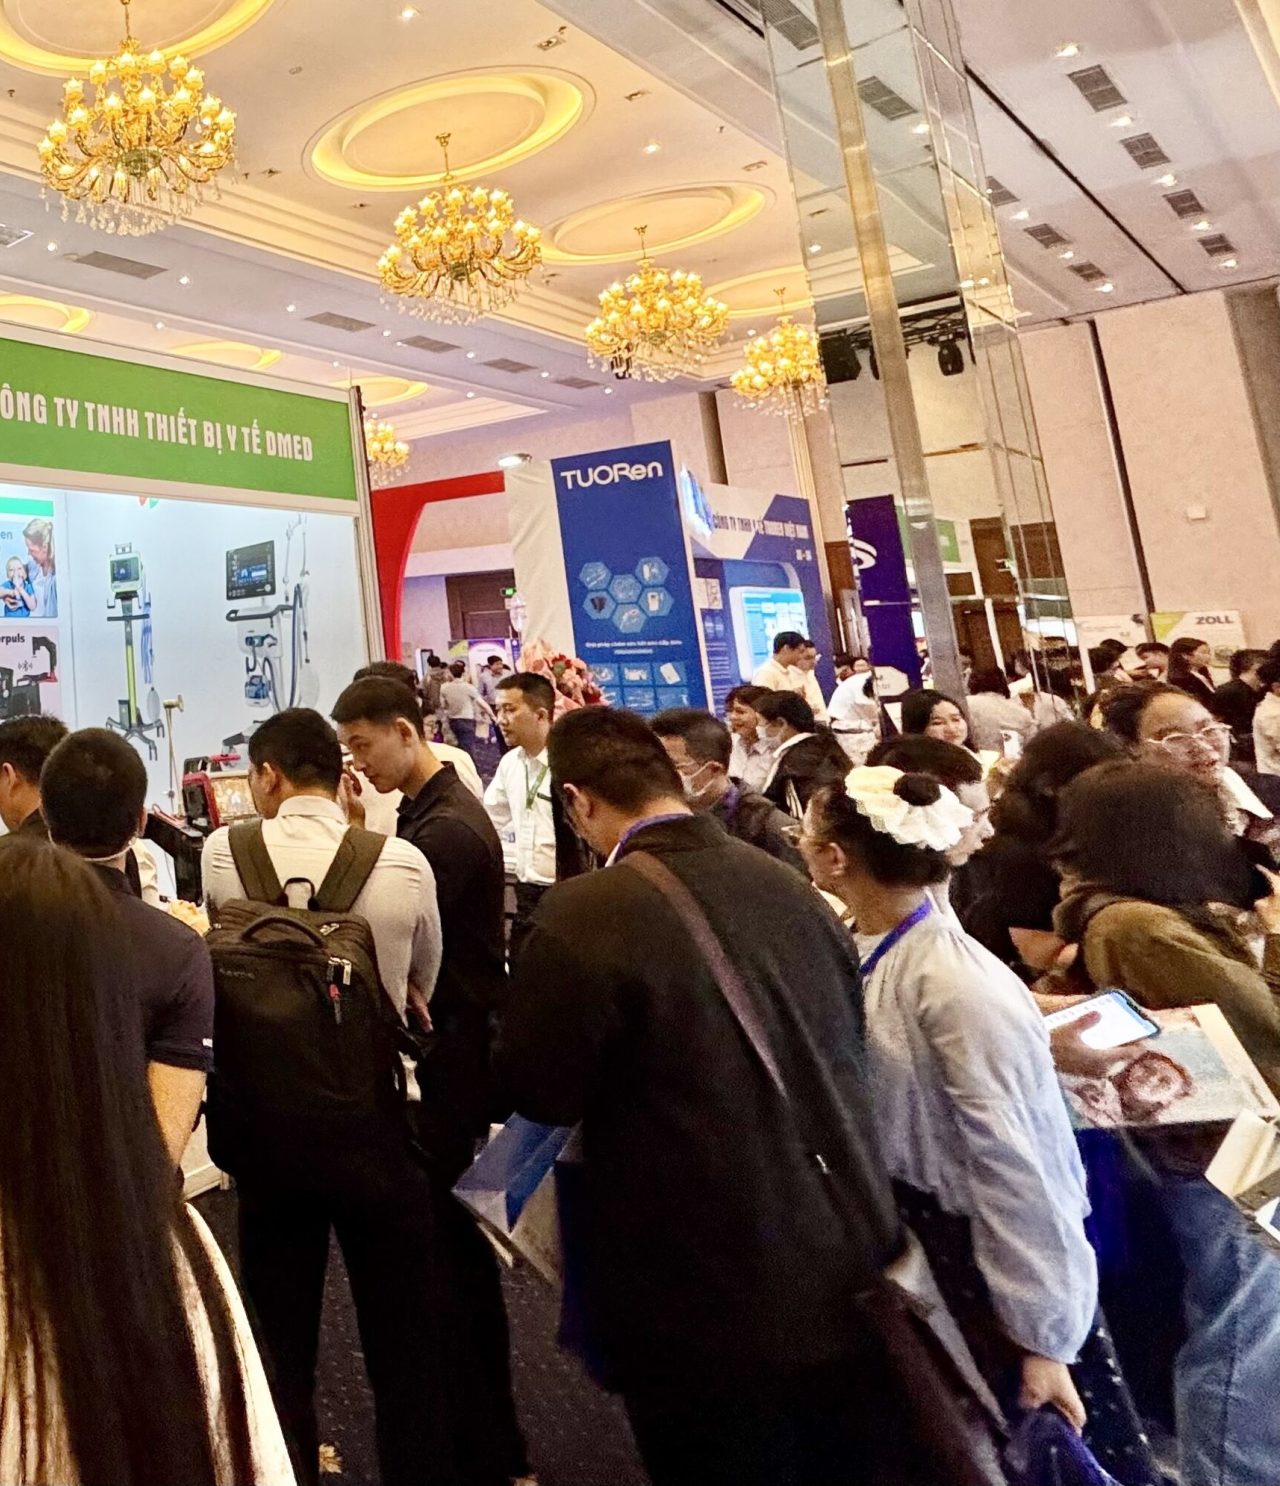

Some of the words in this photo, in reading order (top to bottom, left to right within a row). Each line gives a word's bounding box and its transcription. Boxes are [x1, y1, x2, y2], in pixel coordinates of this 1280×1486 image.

[53, 396, 78, 429] TY
[84, 402, 139, 438] TNHH
[144, 406, 197, 446] THIẾT
[203, 421, 222, 455] BỊ
[225, 424, 237, 451] Y
[240, 418, 261, 455] TẾ
[265, 430, 313, 461] DMED
[1195, 615, 1234, 625] ZOLL
